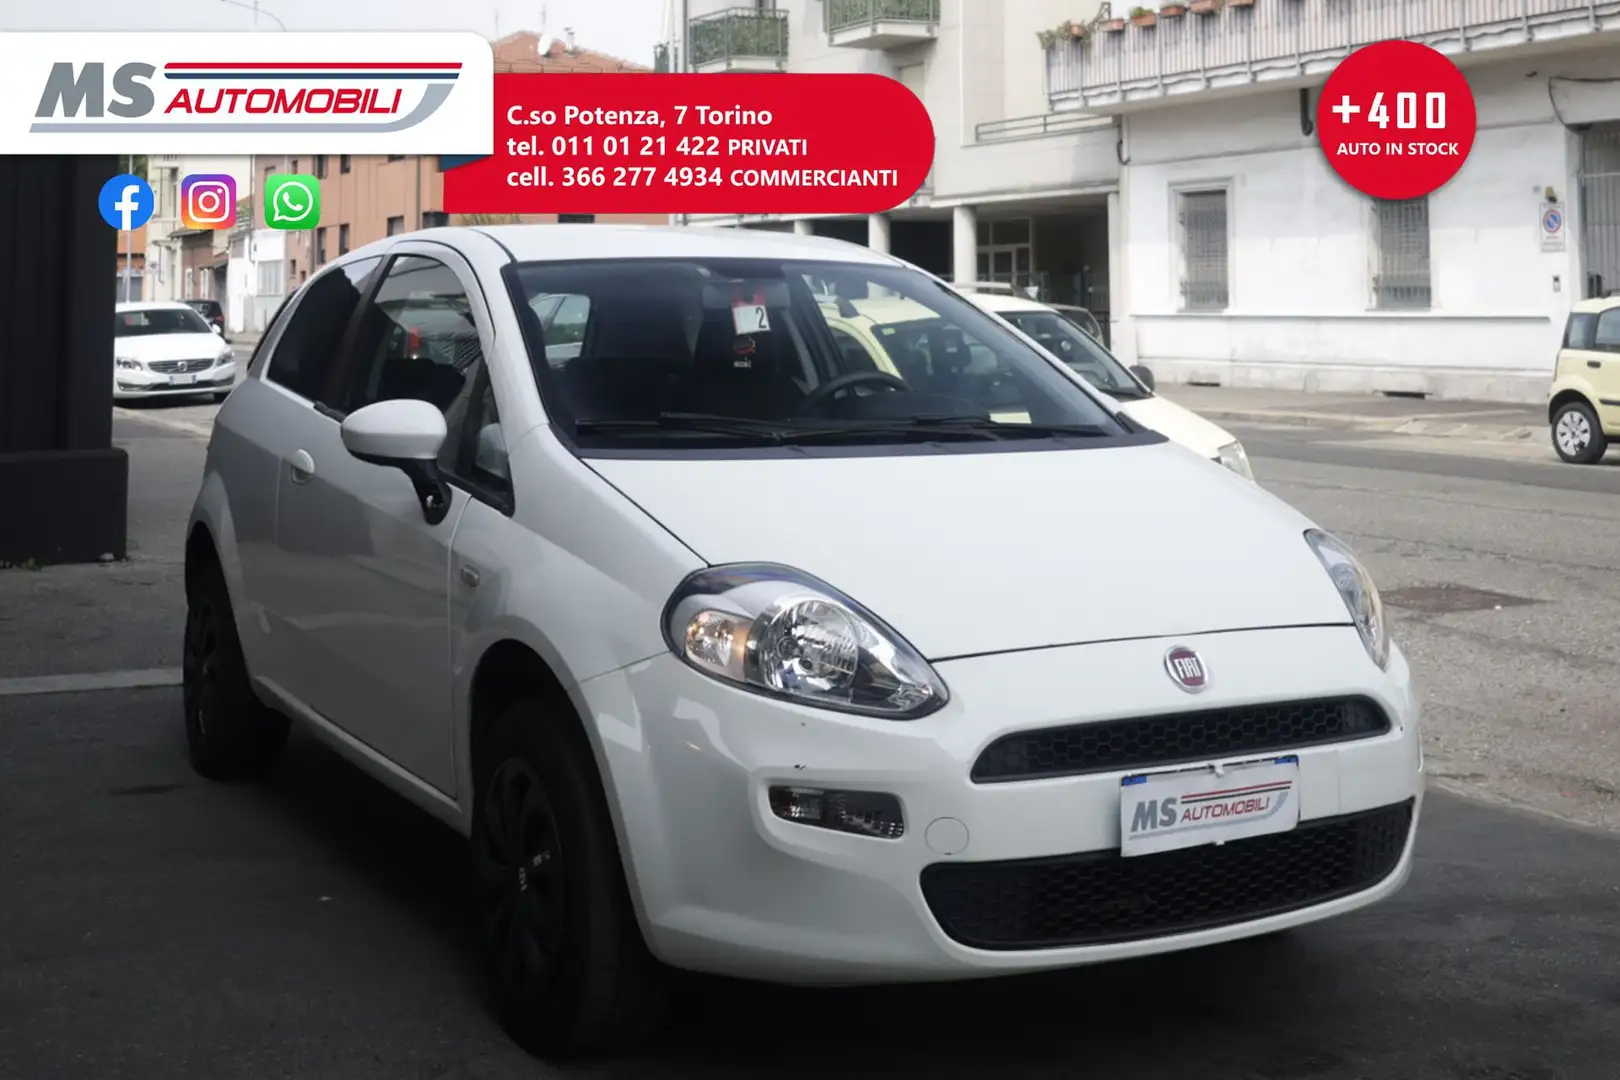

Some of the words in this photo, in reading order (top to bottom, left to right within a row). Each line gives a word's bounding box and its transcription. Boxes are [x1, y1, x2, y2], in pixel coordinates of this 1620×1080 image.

[1173, 657, 1202, 679] FIAT
[1130, 797, 1178, 833] MS
[1180, 796, 1271, 824] AUTOMOBILI
